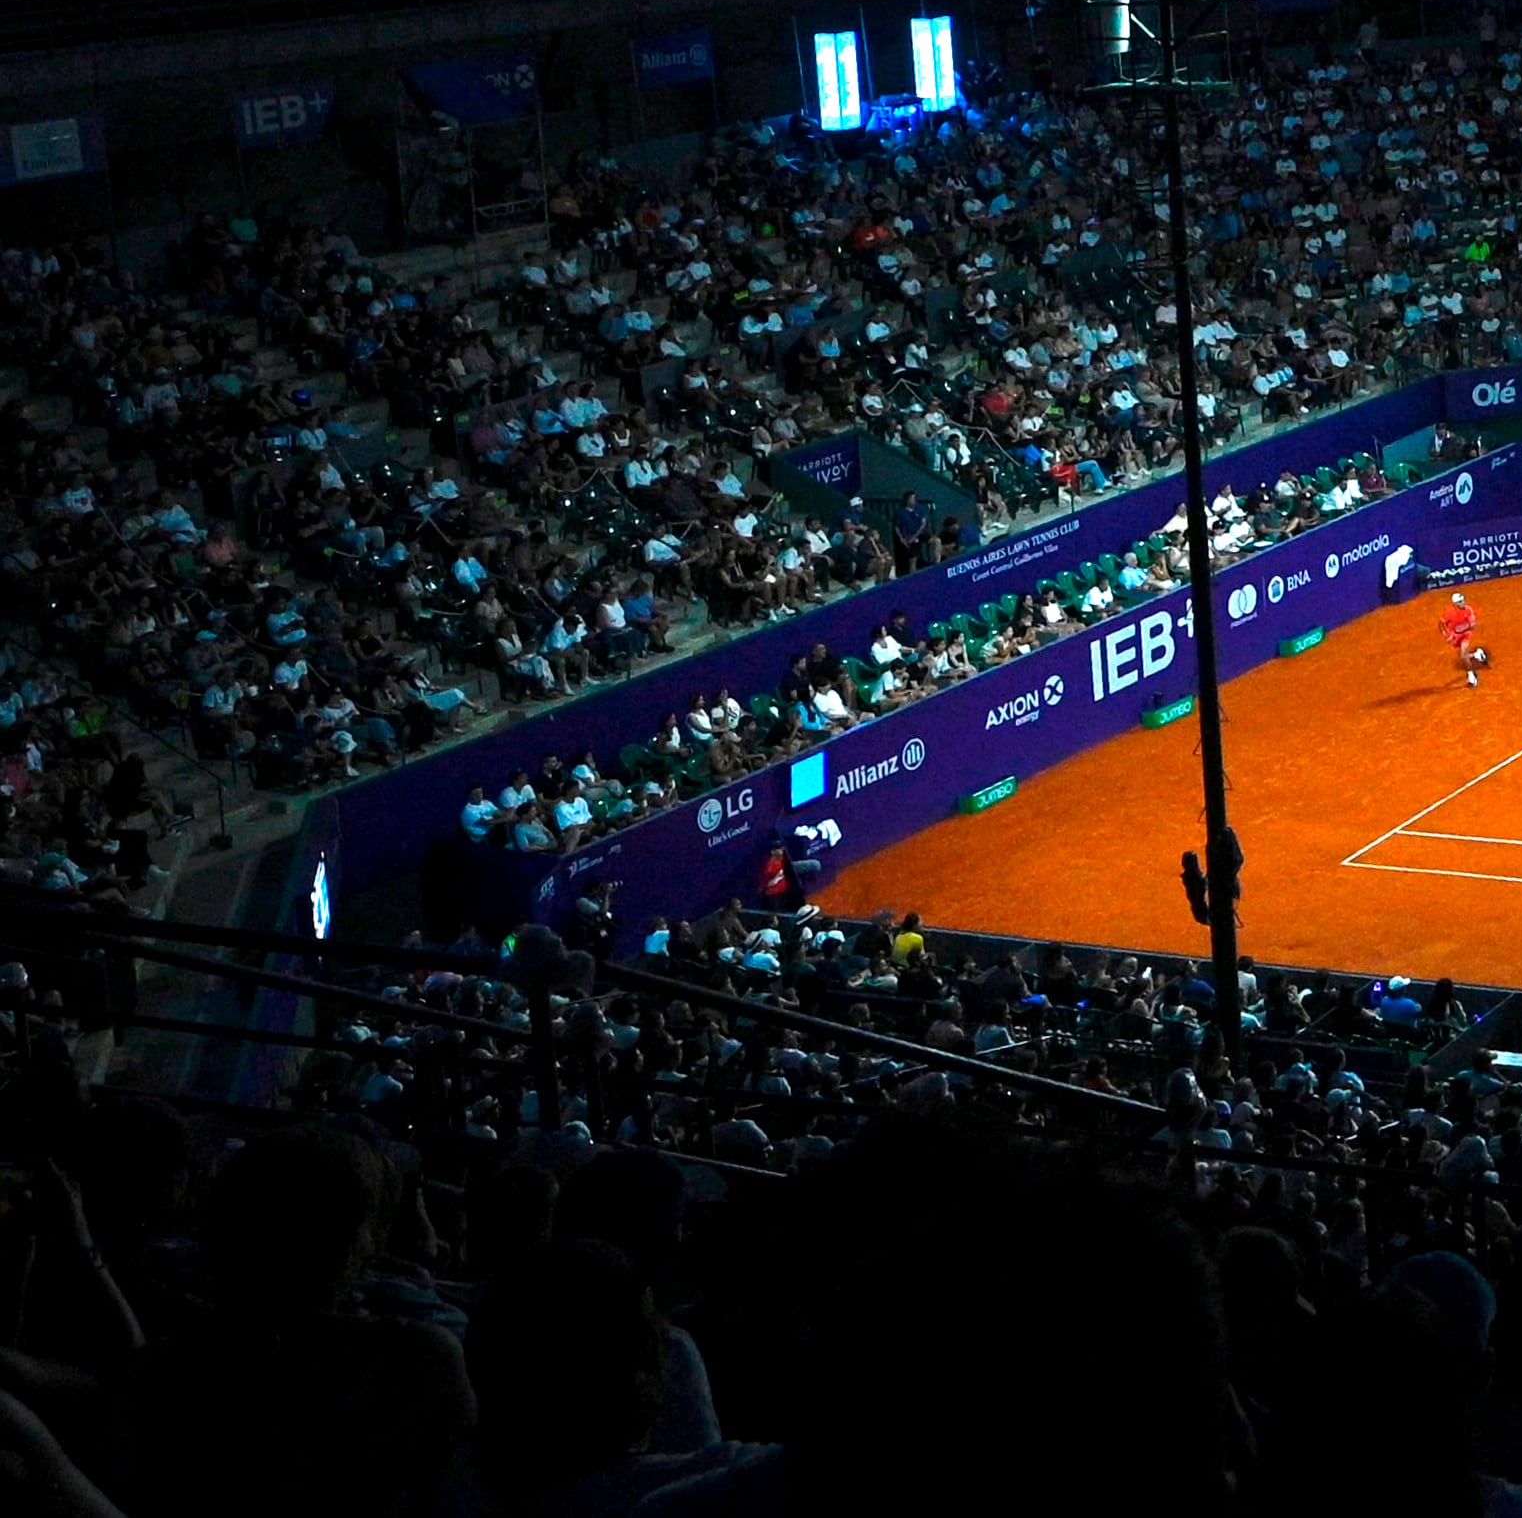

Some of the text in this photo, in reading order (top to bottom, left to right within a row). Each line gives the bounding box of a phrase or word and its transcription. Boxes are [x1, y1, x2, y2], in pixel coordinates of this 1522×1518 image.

[640, 51, 687, 70] Allianz
[239, 91, 329, 135] IEB+
[1471, 378, 1516, 408] Olé
[946, 519, 1080, 578] BUENOS AIRES LAWN TENNIS CLUB
[1341, 534, 1390, 567] motorola
[1462, 532, 1520, 548] MARRIOTT
[1286, 569, 1312, 592] BNA
[1090, 598, 1195, 702] IEB+
[1294, 631, 1323, 654] JUMBO
[985, 690, 1040, 730] AXION
[1159, 701, 1193, 724] JUMBO
[834, 755, 899, 799] Allianz
[726, 788, 754, 818] LG
[977, 782, 1013, 808] JUMBO
